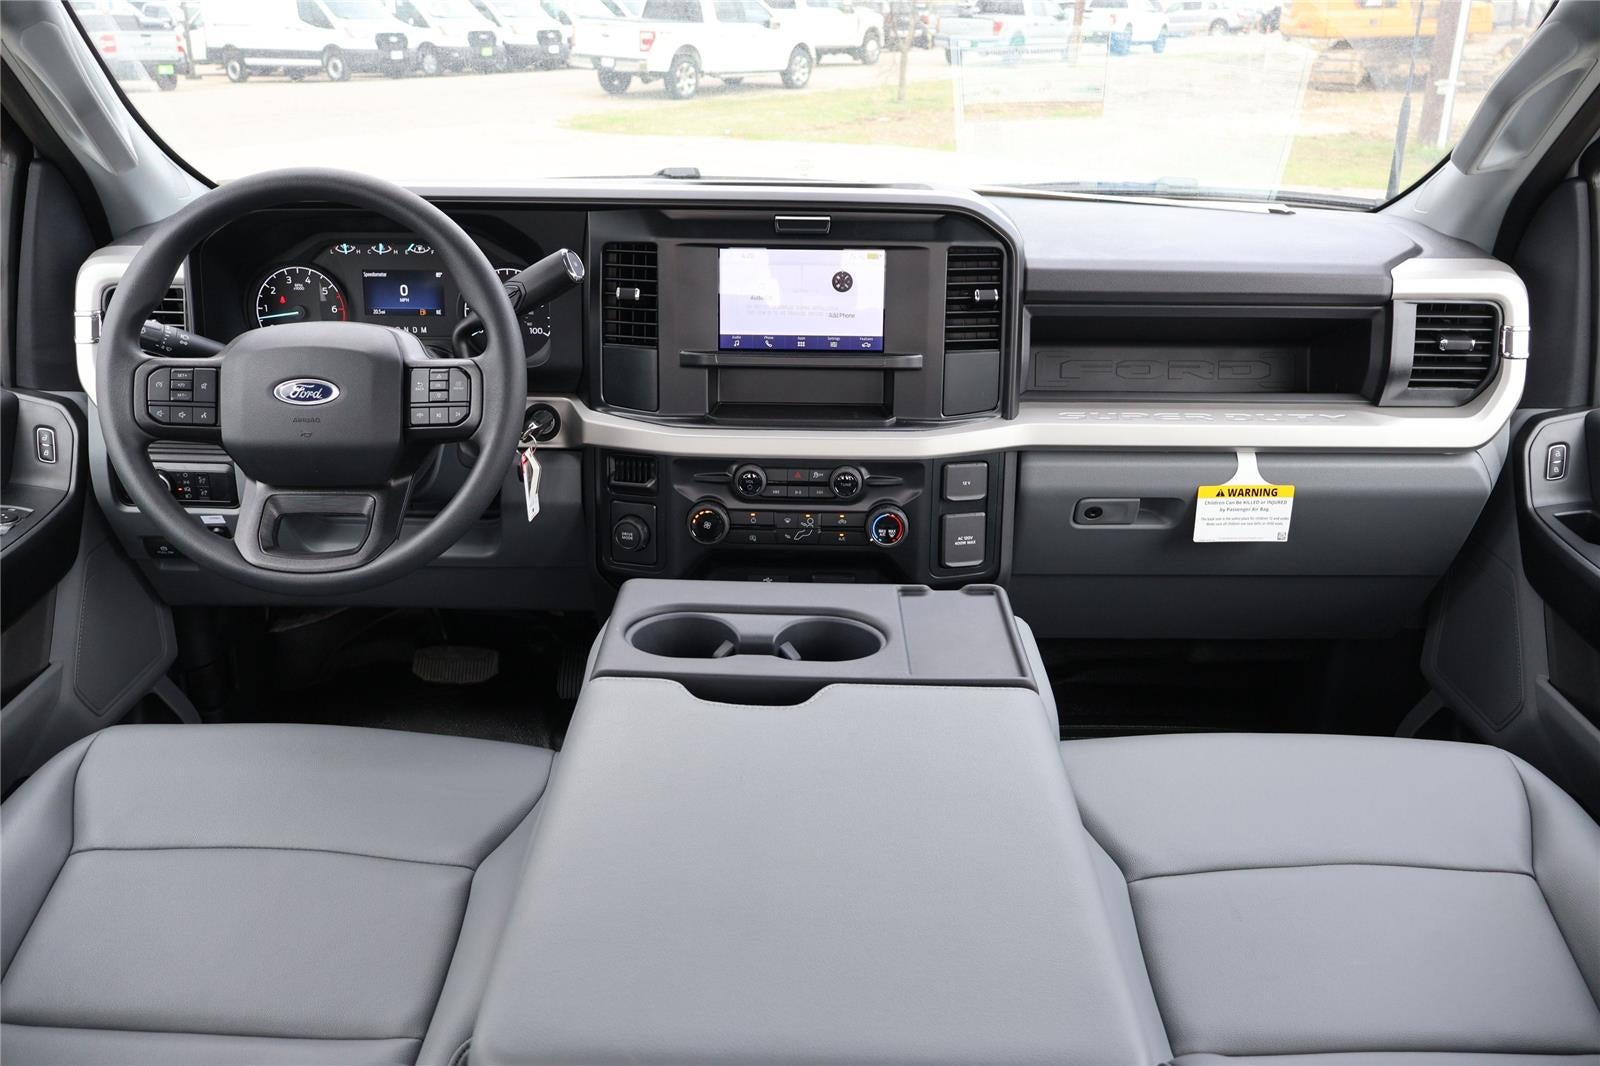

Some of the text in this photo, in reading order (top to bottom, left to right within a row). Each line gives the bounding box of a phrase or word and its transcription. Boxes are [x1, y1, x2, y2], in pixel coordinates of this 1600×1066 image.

[286, 276, 292, 284] 3
[305, 276, 311, 284] 4
[270, 287, 276, 295] 2
[322, 287, 328, 295] 5
[400, 284, 409, 297] 0
[264, 304, 268, 312] 1
[331, 305, 338, 313] 6
[412, 326, 418, 334] D
[420, 326, 427, 334] M
[529, 327, 543, 335] 100
[1059, 360, 1272, 380] FORD
[290, 384, 323, 399] Ford
[1057, 410, 1346, 421] SUPER DUTY
[1227, 488, 1278, 497] WARNING
